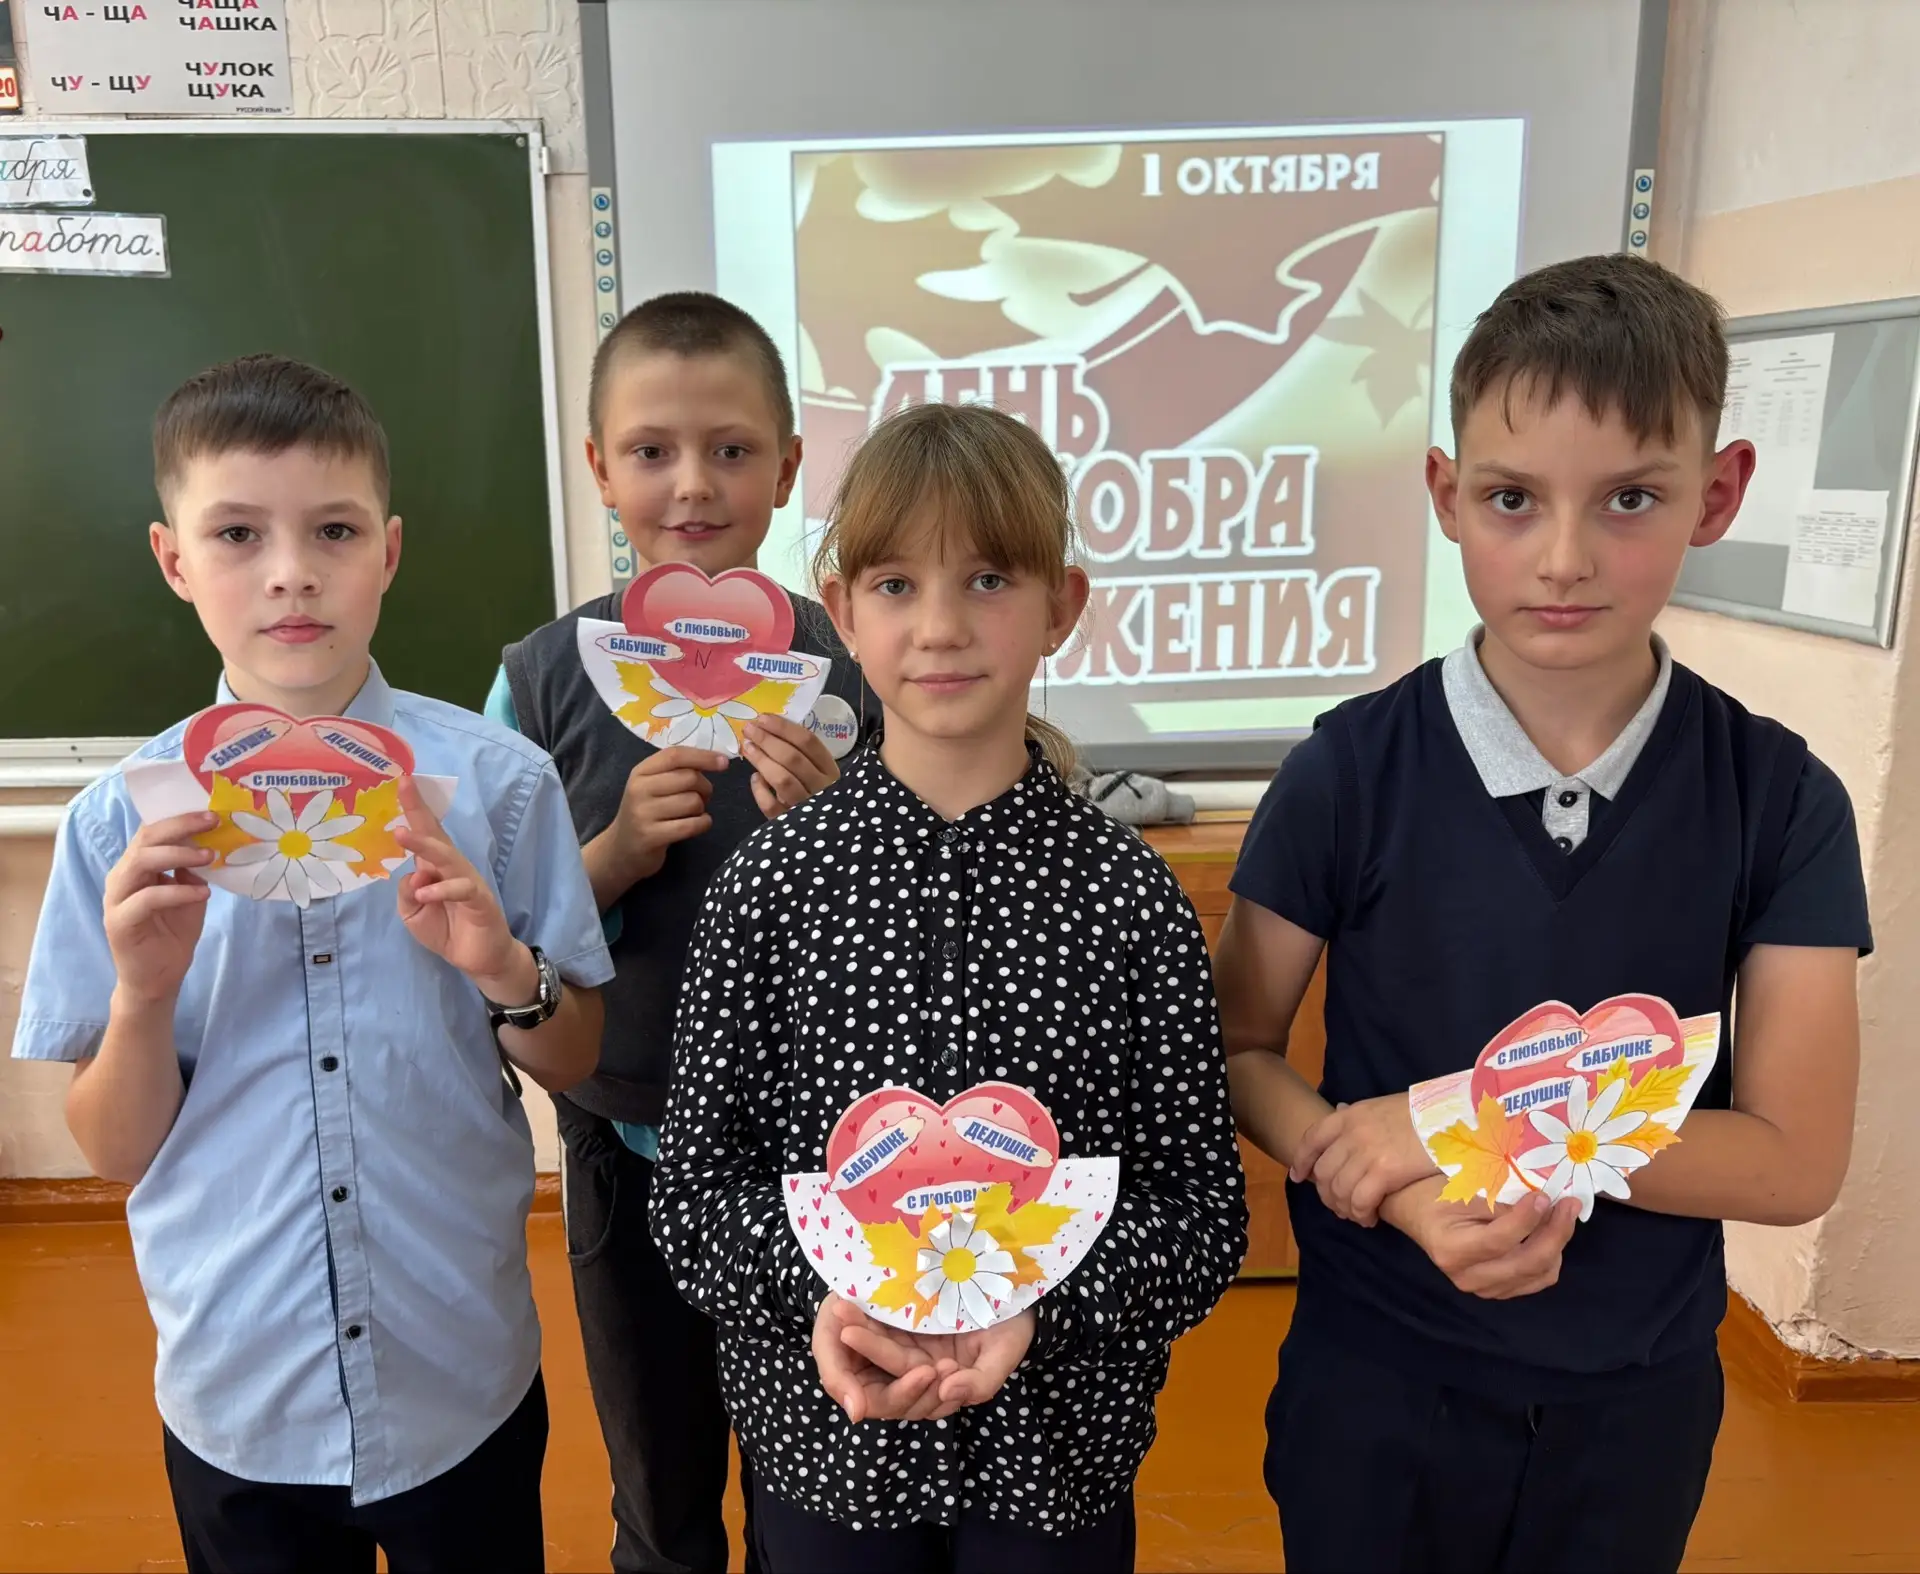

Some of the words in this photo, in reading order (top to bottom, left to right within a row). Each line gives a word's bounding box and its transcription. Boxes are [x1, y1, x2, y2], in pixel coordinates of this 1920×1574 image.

[44, 6, 78, 21] ЧА
[104, 5, 147, 23] ЩА
[179, 17, 277, 31] ЧАШКА
[185, 62, 274, 77] ЧУЛОК
[51, 75, 83, 91] ЧУ
[109, 75, 151, 93] ЩУ
[188, 84, 264, 99] ЩУКА
[1177, 152, 1380, 196] ОКТЯБРЯ
[1070, 447, 1318, 561] ОБРА
[674, 621, 683, 633] С
[684, 622, 746, 640] ЛЮБОВЬЮ!
[1036, 567, 1381, 686] ЖЕНИЯ
[610, 637, 668, 657] БАБУШКЕ
[746, 656, 804, 675] ДЕДУШКЕ
[210, 726, 276, 768] БАБУШКЕ
[323, 731, 392, 771] ДЕДУШКЕ
[253, 775, 262, 786] С
[265, 775, 346, 786] ЛЮБОВЬЮ!
[1497, 1052, 1506, 1065] С
[1508, 1030, 1583, 1063] ЛЮБОВЬЮ!
[1581, 1039, 1652, 1068] БАБУШКЕ
[963, 1121, 1038, 1163] ДЕДУШКЕ
[841, 1127, 909, 1183] БАБУШКЕ
[907, 1196, 916, 1208] С
